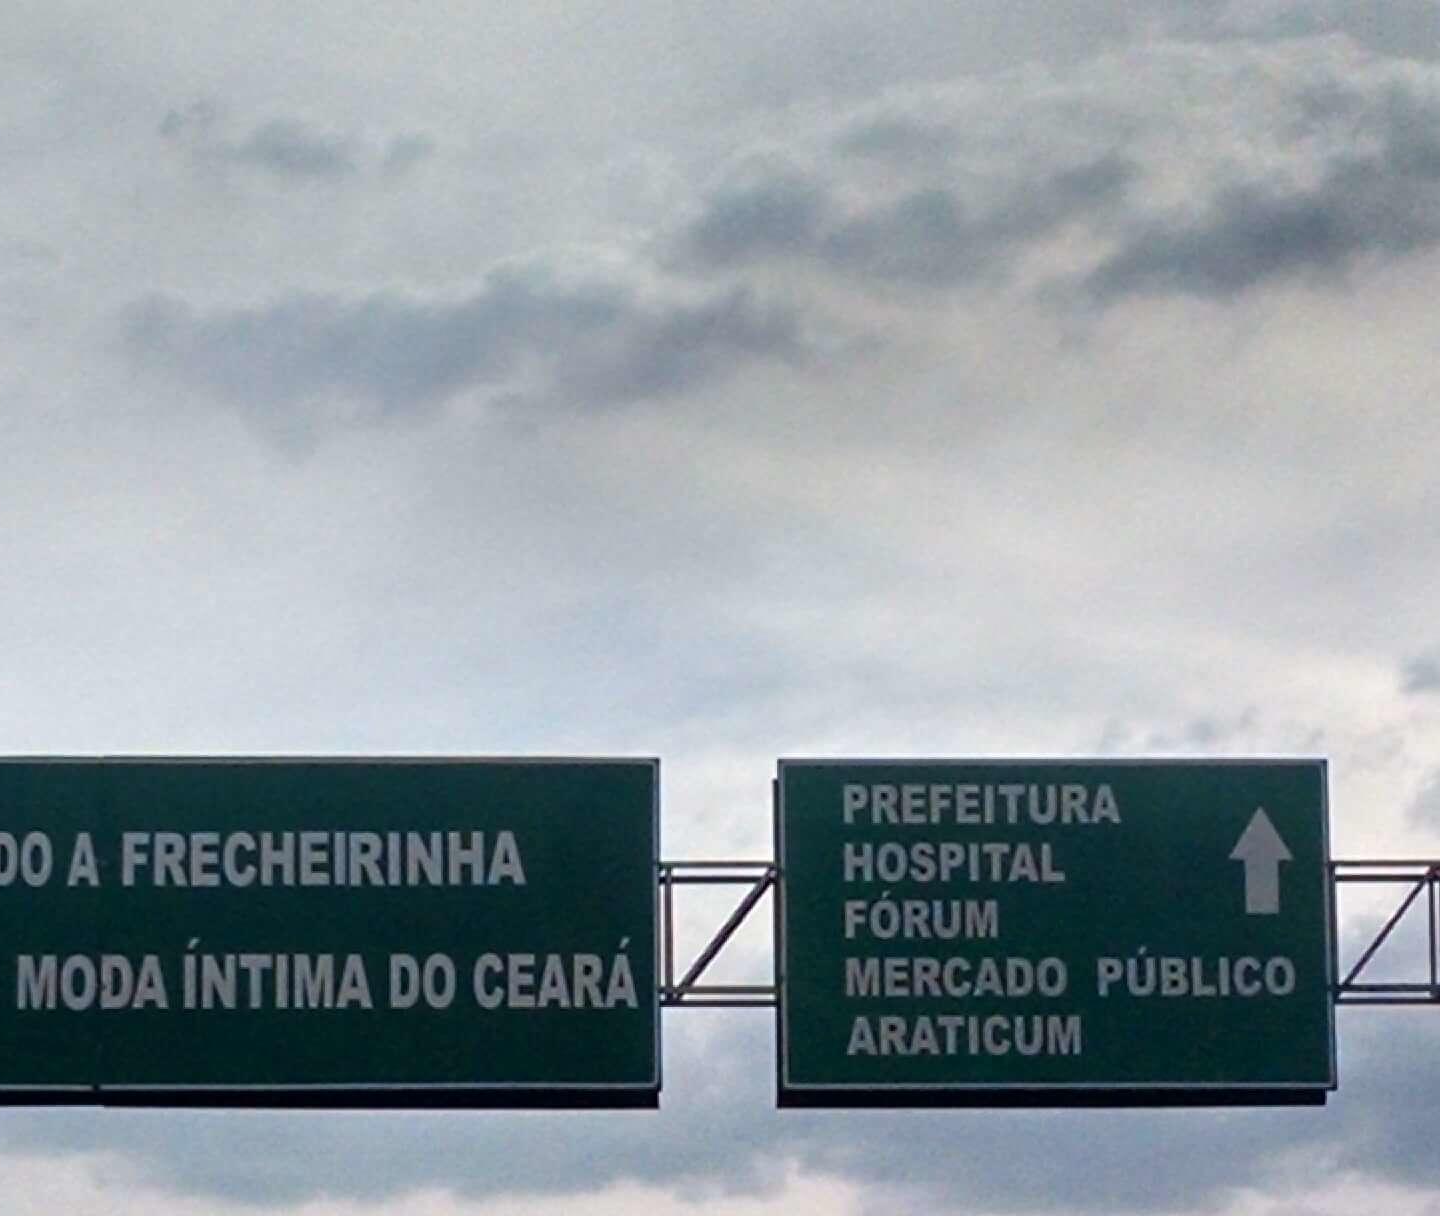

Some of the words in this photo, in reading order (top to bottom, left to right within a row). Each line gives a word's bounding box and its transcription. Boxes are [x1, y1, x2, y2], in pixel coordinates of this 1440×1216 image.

[842, 783, 1122, 825] PREFEITURA
[66, 831, 100, 887] A
[121, 829, 526, 887] FRECHEIRINHA
[843, 842, 1066, 883] HOSPITAL
[843, 890, 999, 939] FÓRUM
[16, 953, 169, 1011] MODA
[183, 937, 374, 1010] ÍNTIMA
[389, 952, 457, 1009] DO
[473, 936, 639, 1009] CEARÁ
[845, 956, 1067, 997] MERCADO
[1097, 946, 1296, 997] PÚBLICO
[846, 1015, 1083, 1057] ARATICUM
